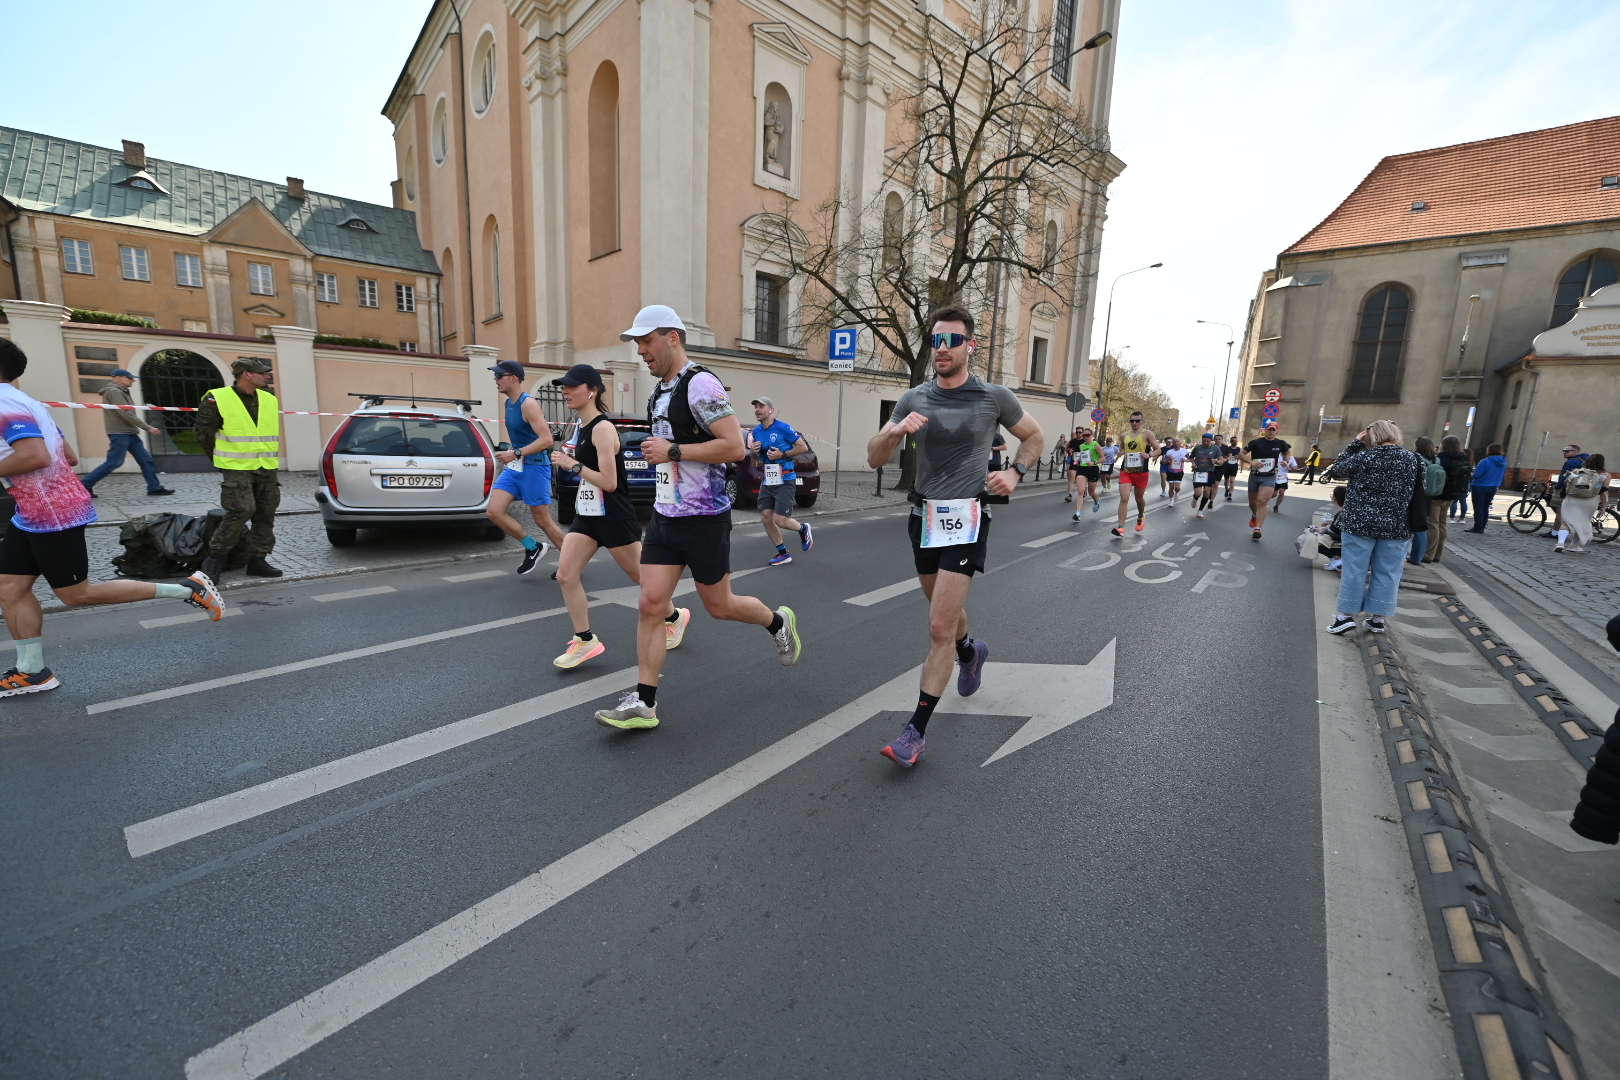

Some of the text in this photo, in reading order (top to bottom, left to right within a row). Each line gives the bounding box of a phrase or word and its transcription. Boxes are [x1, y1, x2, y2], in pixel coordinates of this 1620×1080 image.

[835, 332, 851, 356] P
[830, 361, 852, 369] Koniec
[388, 476, 441, 487] PO 0972S
[939, 518, 963, 531] 156
